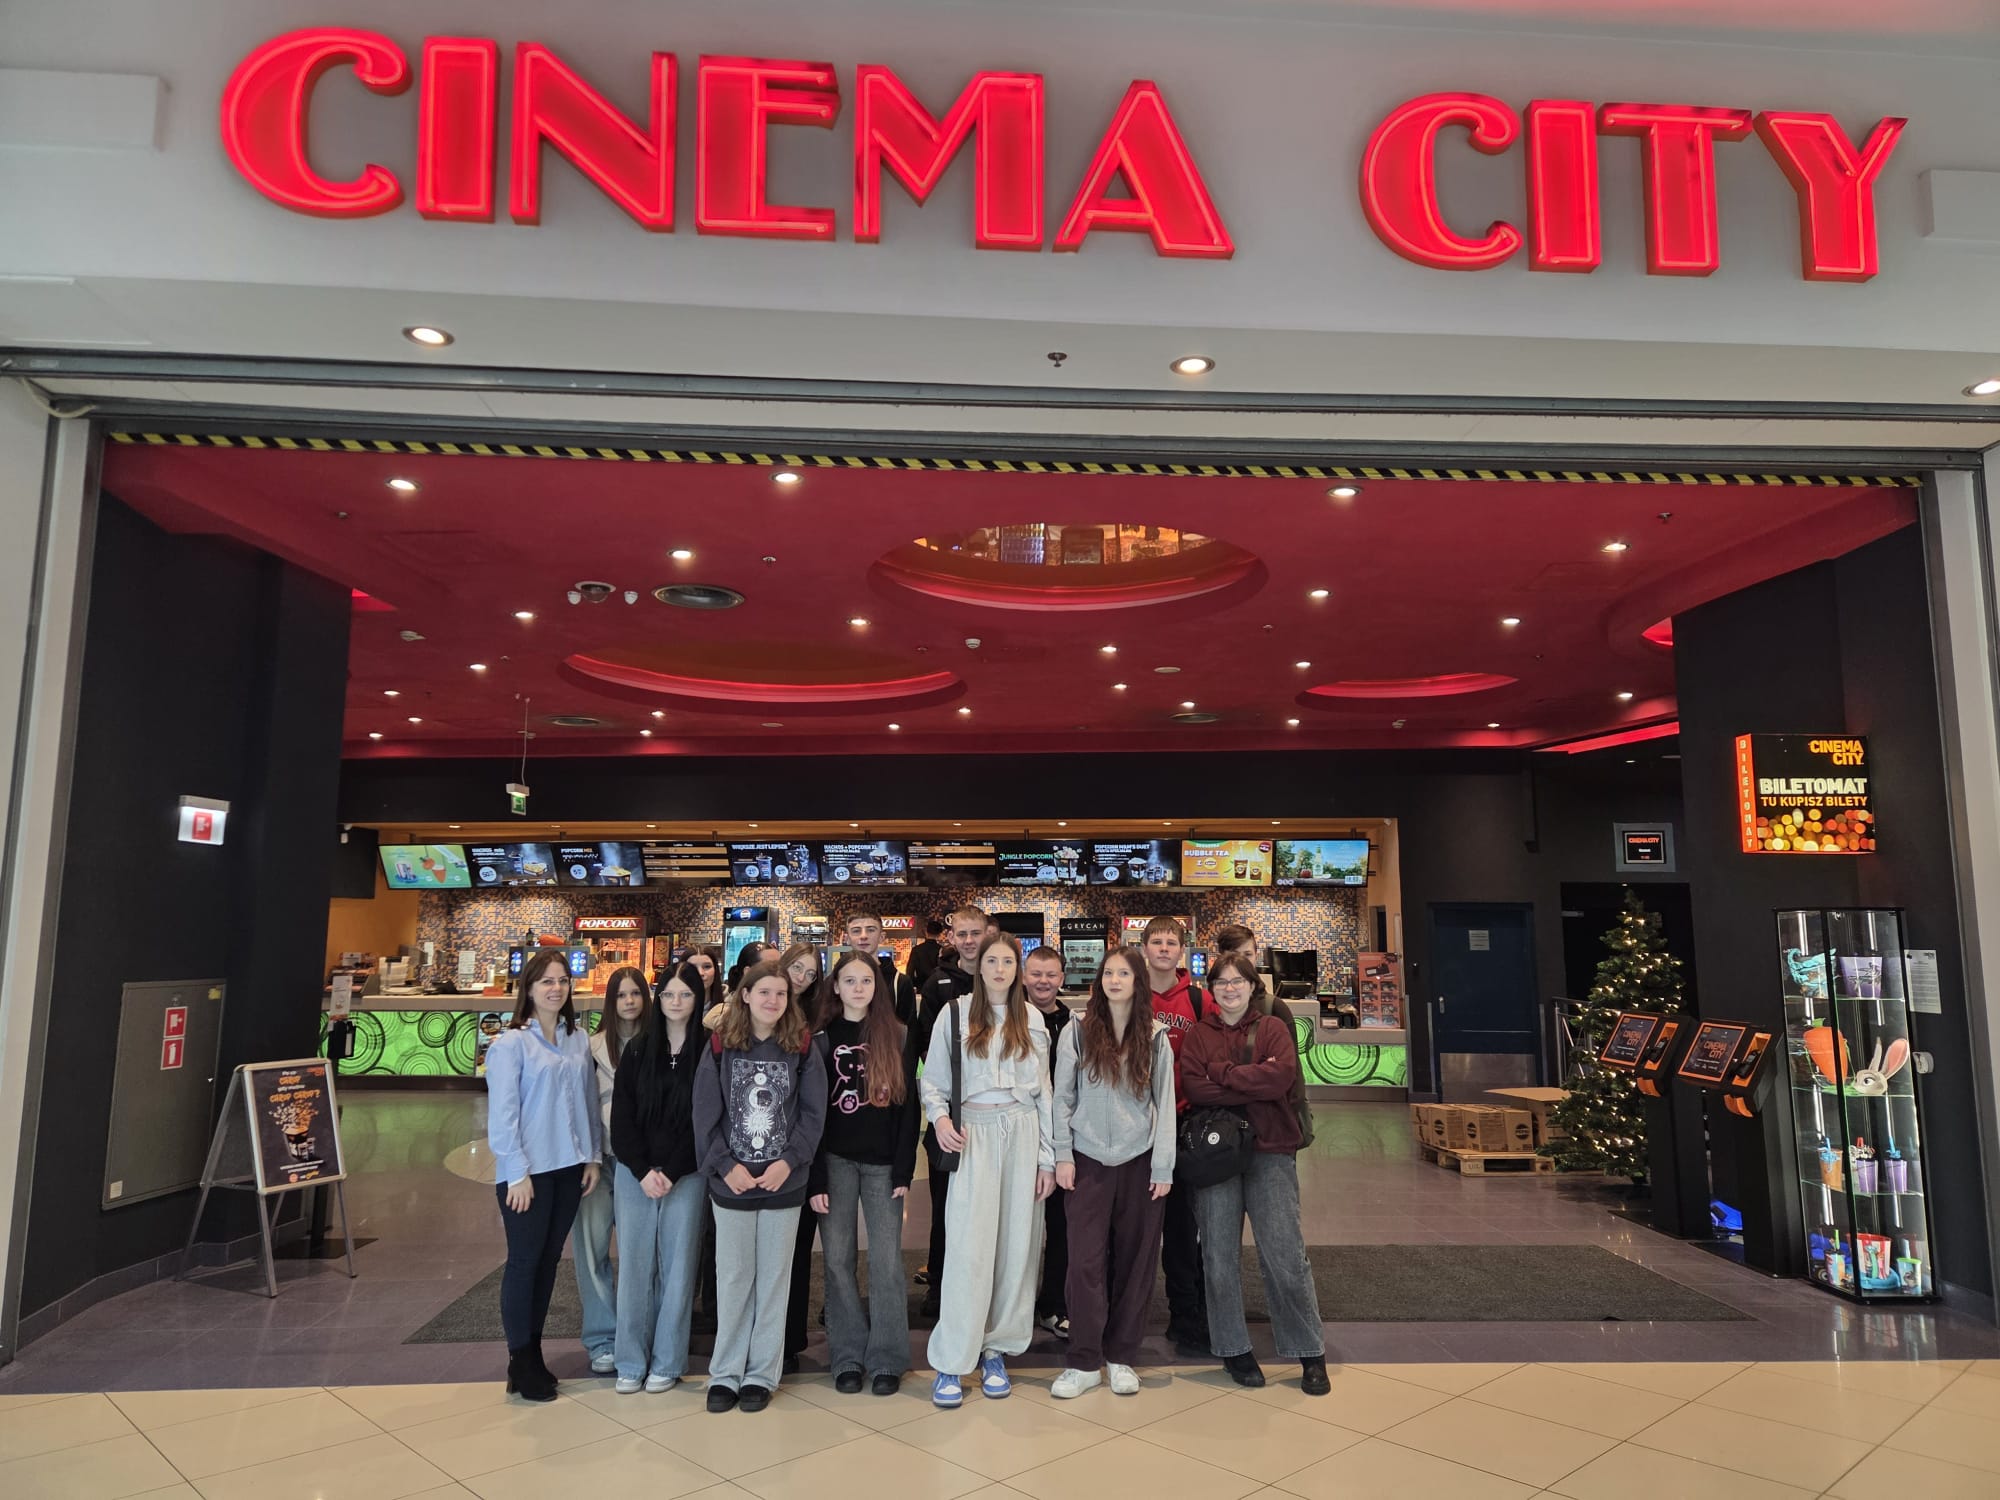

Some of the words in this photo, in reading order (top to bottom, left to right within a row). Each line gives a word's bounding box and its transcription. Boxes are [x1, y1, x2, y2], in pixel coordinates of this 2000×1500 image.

[220, 27, 1234, 259] CINEMA
[1359, 92, 1908, 283] CITY
[1809, 740, 1864, 753] CINEMA
[1832, 752, 1864, 765] CITY
[1759, 778, 1867, 794] BILETOMAT
[1739, 739, 1753, 848] BILETOMAT
[1761, 796, 1777, 807] TU
[1780, 796, 1823, 807] KUPISZ
[1826, 796, 1868, 806] BILETY
[579, 919, 637, 928] POPCORN
[1623, 1030, 1642, 1040] CINEMA
[1627, 1039, 1640, 1047] CITY
[1703, 1040, 1728, 1051] CINEMA
[1709, 1049, 1726, 1059] CITY
